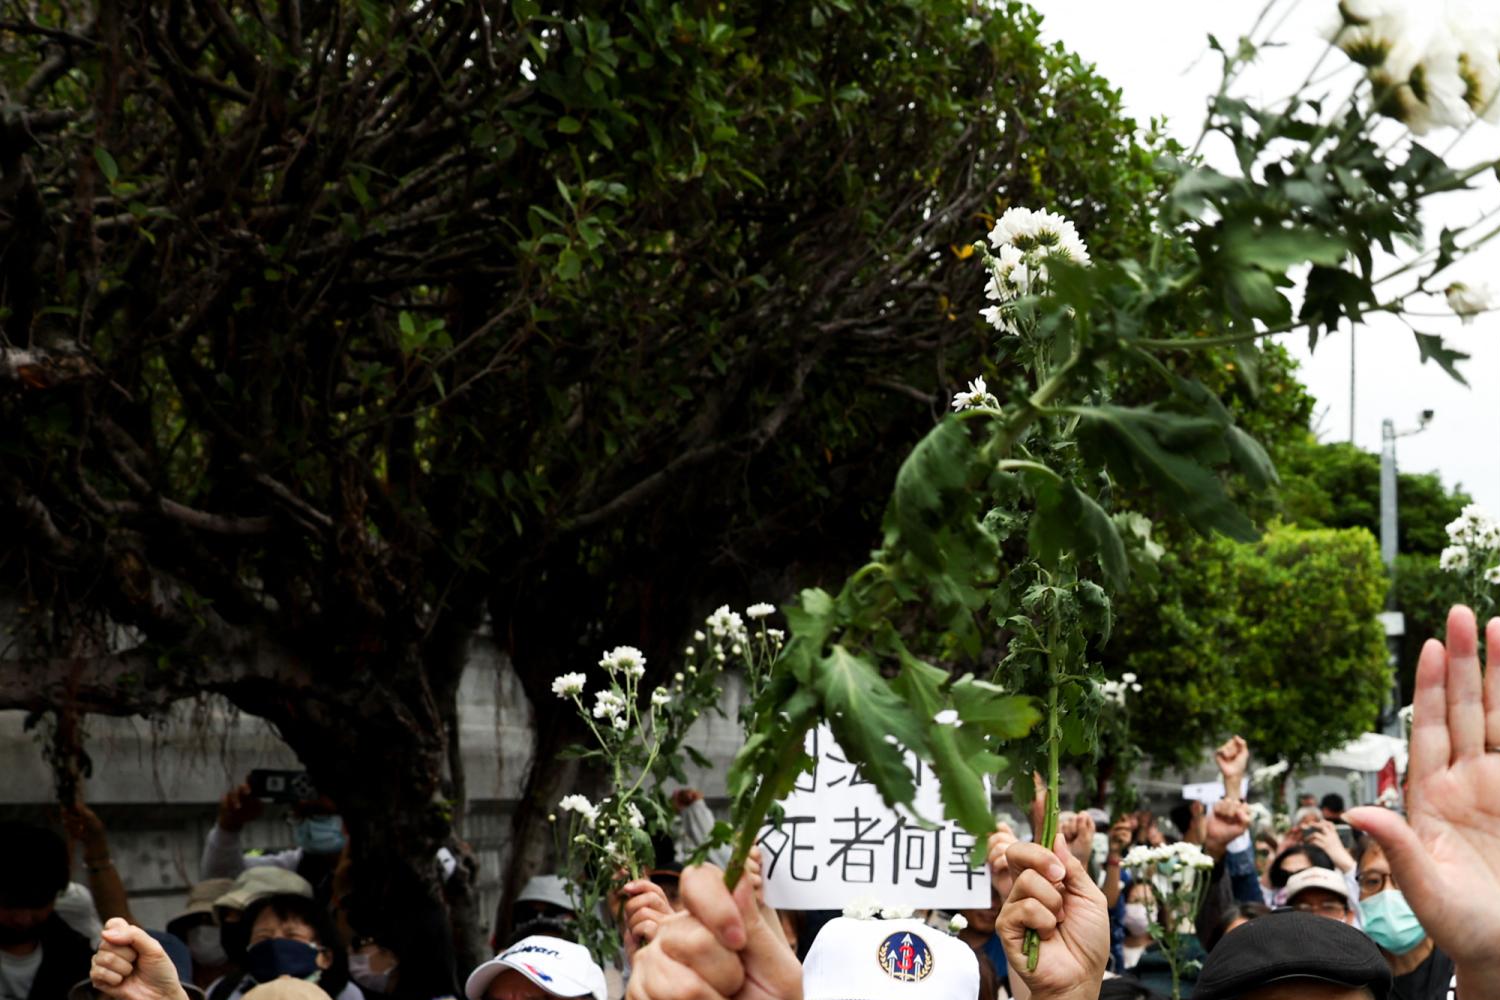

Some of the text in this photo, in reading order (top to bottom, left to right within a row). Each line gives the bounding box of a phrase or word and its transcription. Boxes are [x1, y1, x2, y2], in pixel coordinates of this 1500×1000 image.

[756, 806, 986, 891] 死者何辜
[897, 945, 915, 970] 3
